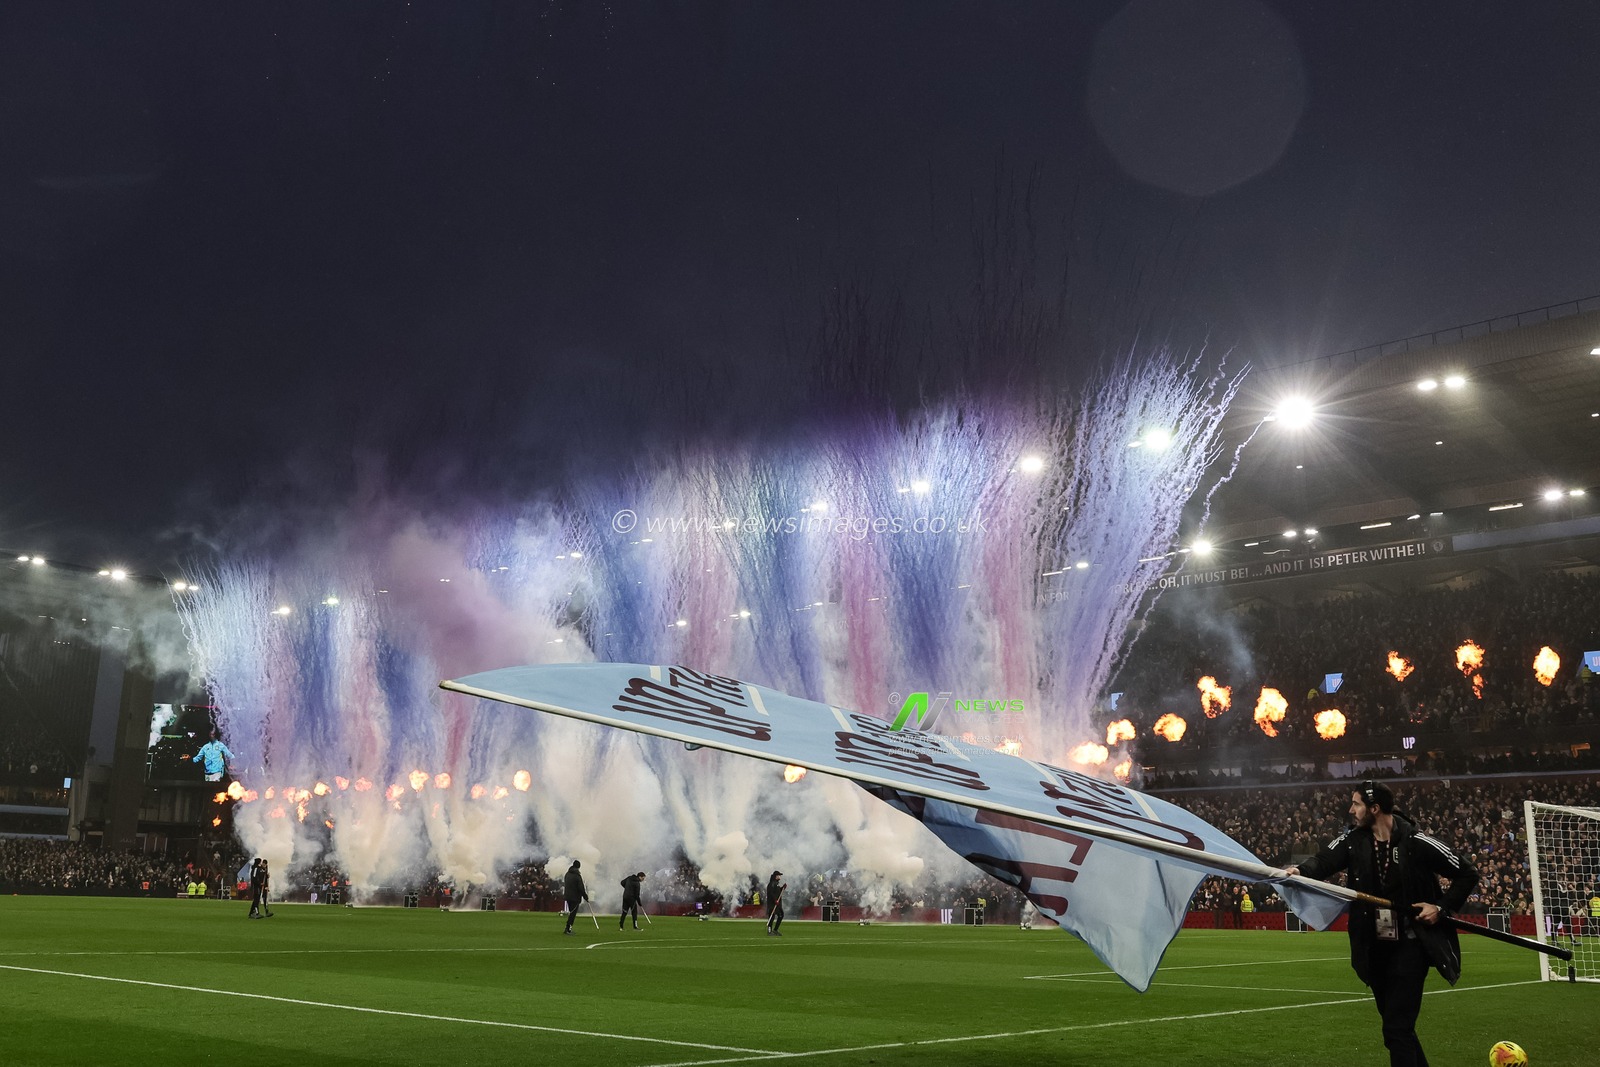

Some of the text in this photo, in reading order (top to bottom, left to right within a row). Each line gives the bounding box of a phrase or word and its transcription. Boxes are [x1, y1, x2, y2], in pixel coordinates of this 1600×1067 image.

[1181, 574, 1192, 586] IT
[1194, 570, 1227, 585] MUST
[1294, 559, 1305, 571] IT
[1309, 556, 1324, 570] IS!
[1327, 550, 1368, 567] PETER
[1369, 544, 1415, 561] WITHE
[1402, 736, 1416, 750] UP
